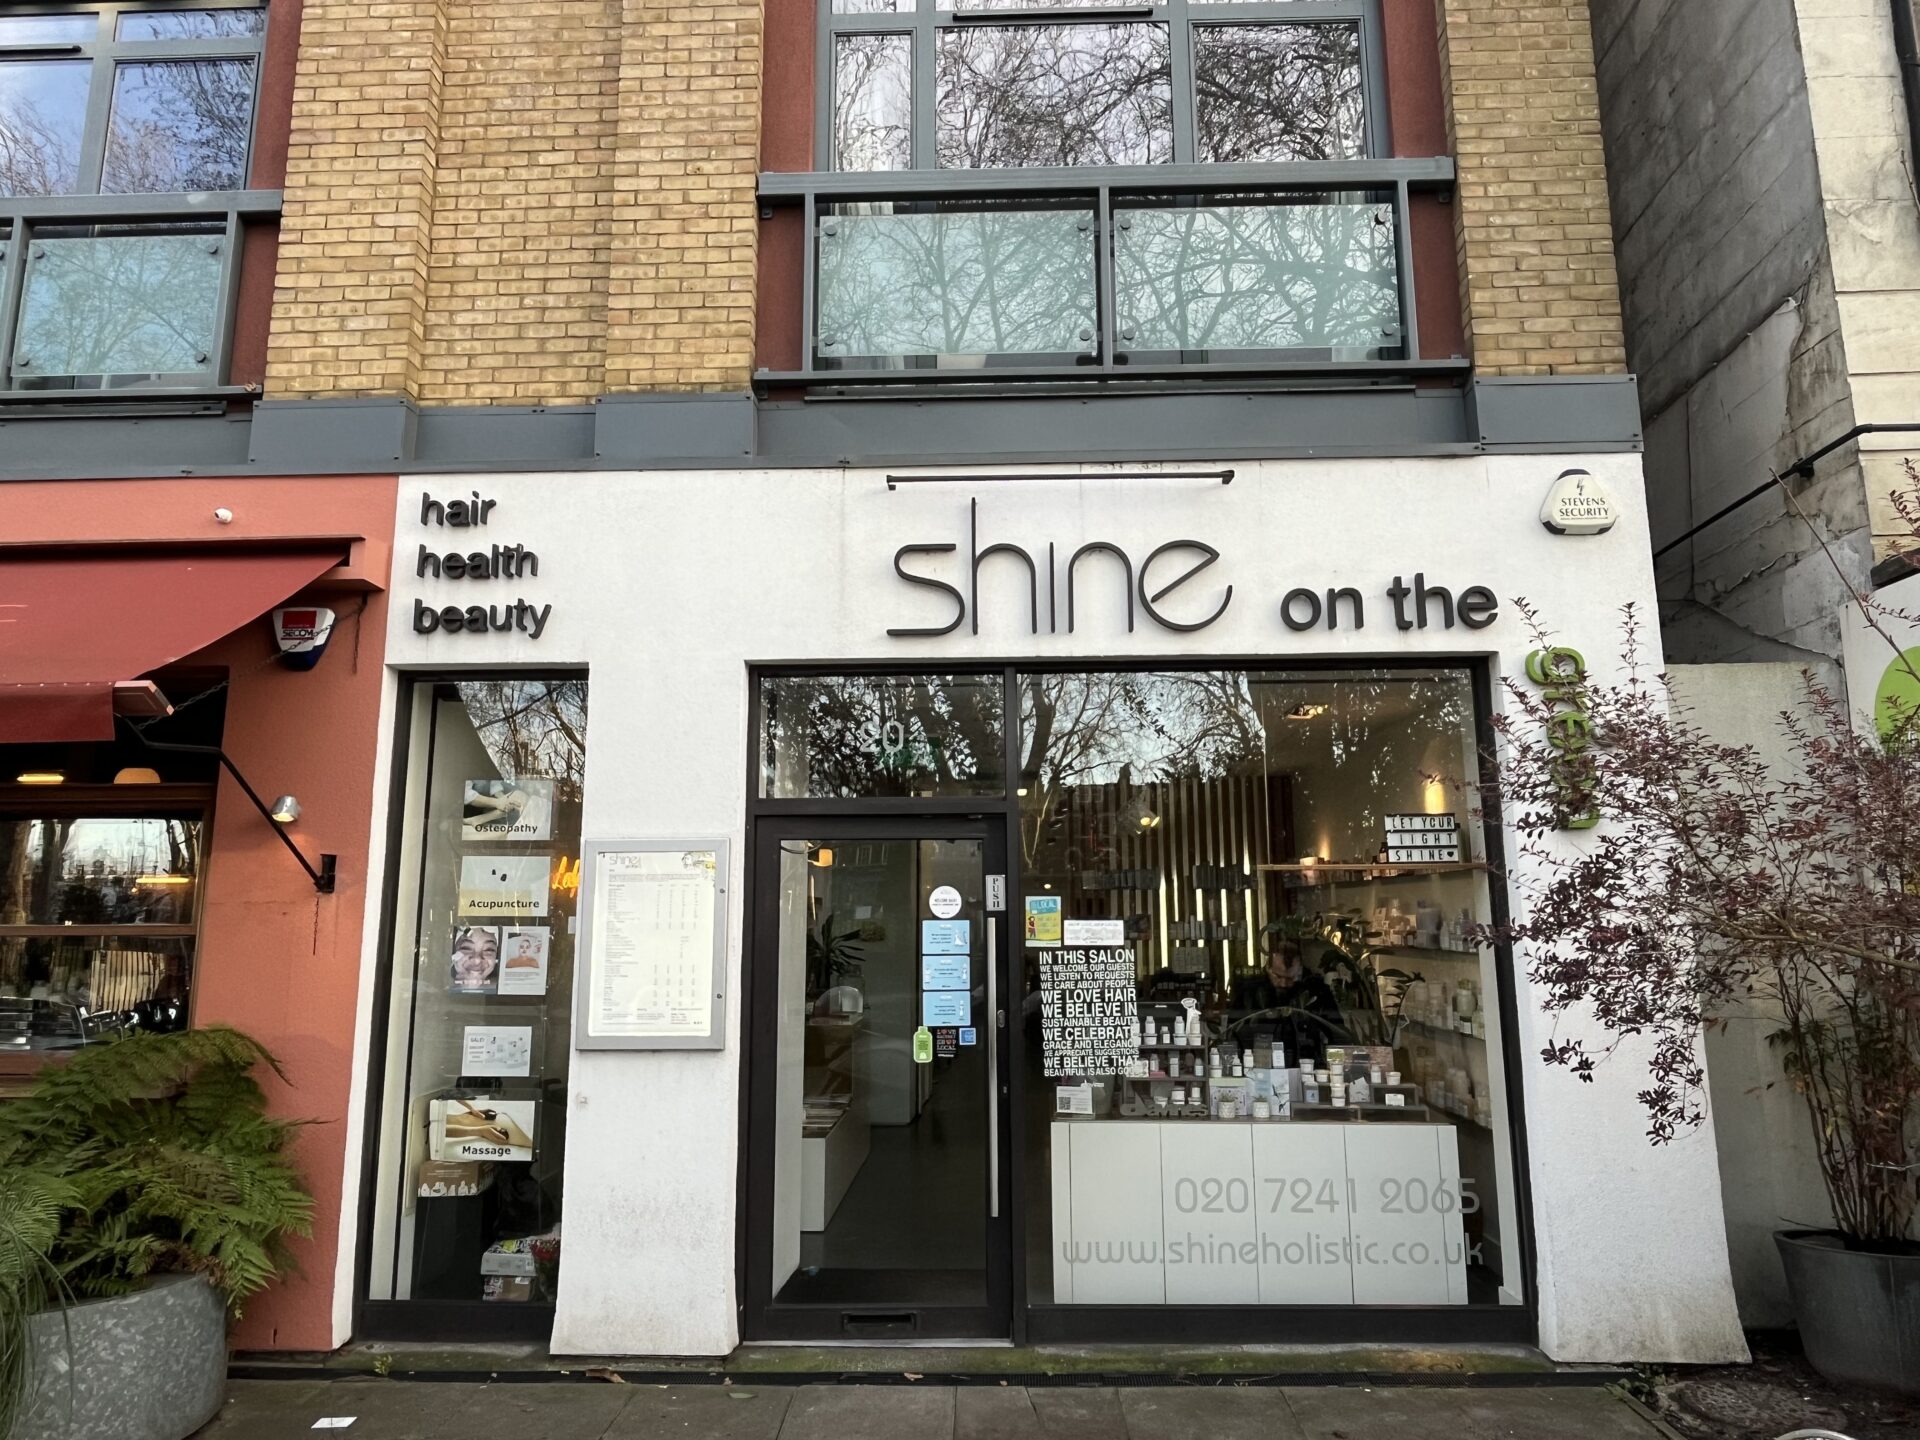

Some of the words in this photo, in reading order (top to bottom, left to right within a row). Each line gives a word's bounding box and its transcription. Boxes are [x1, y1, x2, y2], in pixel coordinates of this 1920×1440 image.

[1561, 497, 1606, 506] STEVENS
[421, 490, 497, 527] hair
[1560, 507, 1609, 517] SECURITY
[416, 543, 539, 580] health
[887, 497, 1233, 636] shine
[1280, 585, 1364, 631] on
[1386, 572, 1499, 631] the
[413, 598, 552, 639] beauty
[860, 720, 904, 752] 20
[475, 824, 538, 834] Osteopathy
[1393, 818, 1414, 829] LET
[1395, 850, 1444, 860] SHINE
[469, 900, 540, 910] Acupuncture
[1039, 951, 1052, 964] IN
[1056, 950, 1086, 964] THIS
[1089, 949, 1135, 963] SALON
[1053, 964, 1088, 972] WELCOME
[1090, 964, 1105, 972] OUR
[1106, 963, 1135, 971] GUESTS
[1040, 973, 1053, 981] WE
[1054, 972, 1080, 980] LISTEN
[1082, 972, 1092, 980] TO
[1094, 971, 1135, 979] REQUESTS
[1041, 982, 1053, 990] WE
[1054, 981, 1075, 989] CARE
[1077, 980, 1103, 989] ABOUT
[1105, 979, 1136, 988] PEOPLE
[1041, 990, 1062, 1004] WE
[1066, 989, 1101, 1003] LOVE
[1105, 988, 1136, 1002] HAIR
[1041, 1004, 1062, 1018] WE
[1066, 1002, 1121, 1017] BELIEVE
[1124, 1002, 1138, 1016] IN
[1042, 1017, 1101, 1027] SUSTAINABLE
[1042, 1028, 1062, 1041] WE
[1043, 1040, 1072, 1050] GRACE
[1074, 1040, 1092, 1049] AND
[1044, 1057, 1061, 1068] WE
[1064, 1056, 1109, 1067] BELIEVE
[1111, 1056, 1139, 1067] THAT
[1044, 1068, 1085, 1077] BEAUTIFUL
[1088, 1068, 1095, 1076] IS
[1096, 1067, 1116, 1075] ALSO
[462, 1145, 511, 1156] Massage
[1175, 1177, 1249, 1214] 020
[1263, 1177, 1357, 1214] 7241
[1379, 1177, 1480, 1214] 2065
[1062, 1232, 1483, 1266] www.shineholistic.co.uk
